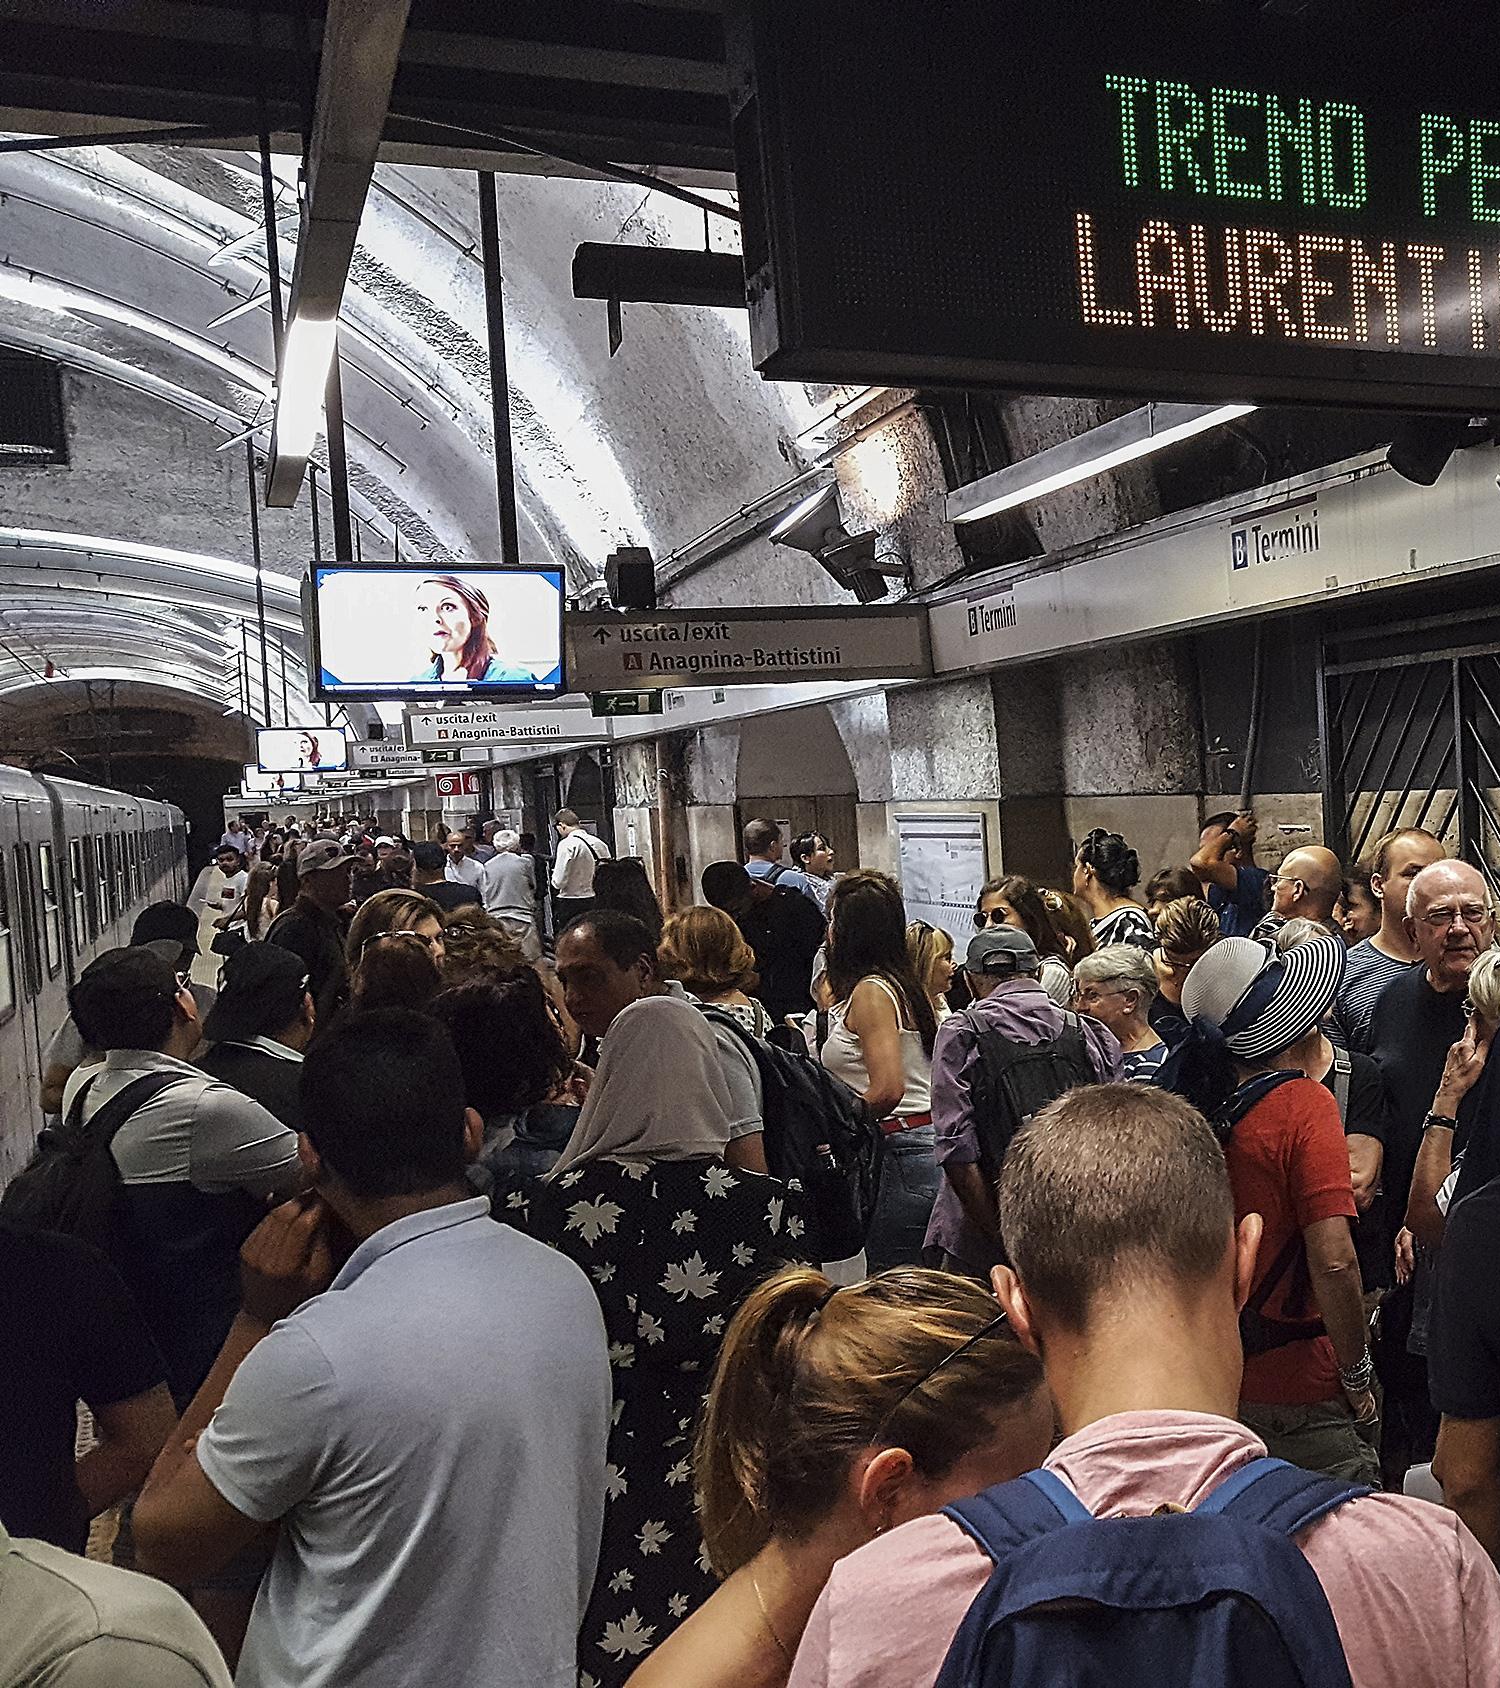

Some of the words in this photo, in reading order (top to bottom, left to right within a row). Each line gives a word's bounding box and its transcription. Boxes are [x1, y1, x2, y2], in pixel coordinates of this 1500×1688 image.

[1105, 74, 1367, 208] TRENO
[1251, 509, 1319, 564] Termini
[978, 596, 1017, 633] Termini
[620, 622, 730, 644] uscita/exit
[649, 646, 841, 673] Anagnina-Battistini
[436, 711, 497, 725] uscita/exit
[451, 725, 560, 741] Anagnina-Battistini
